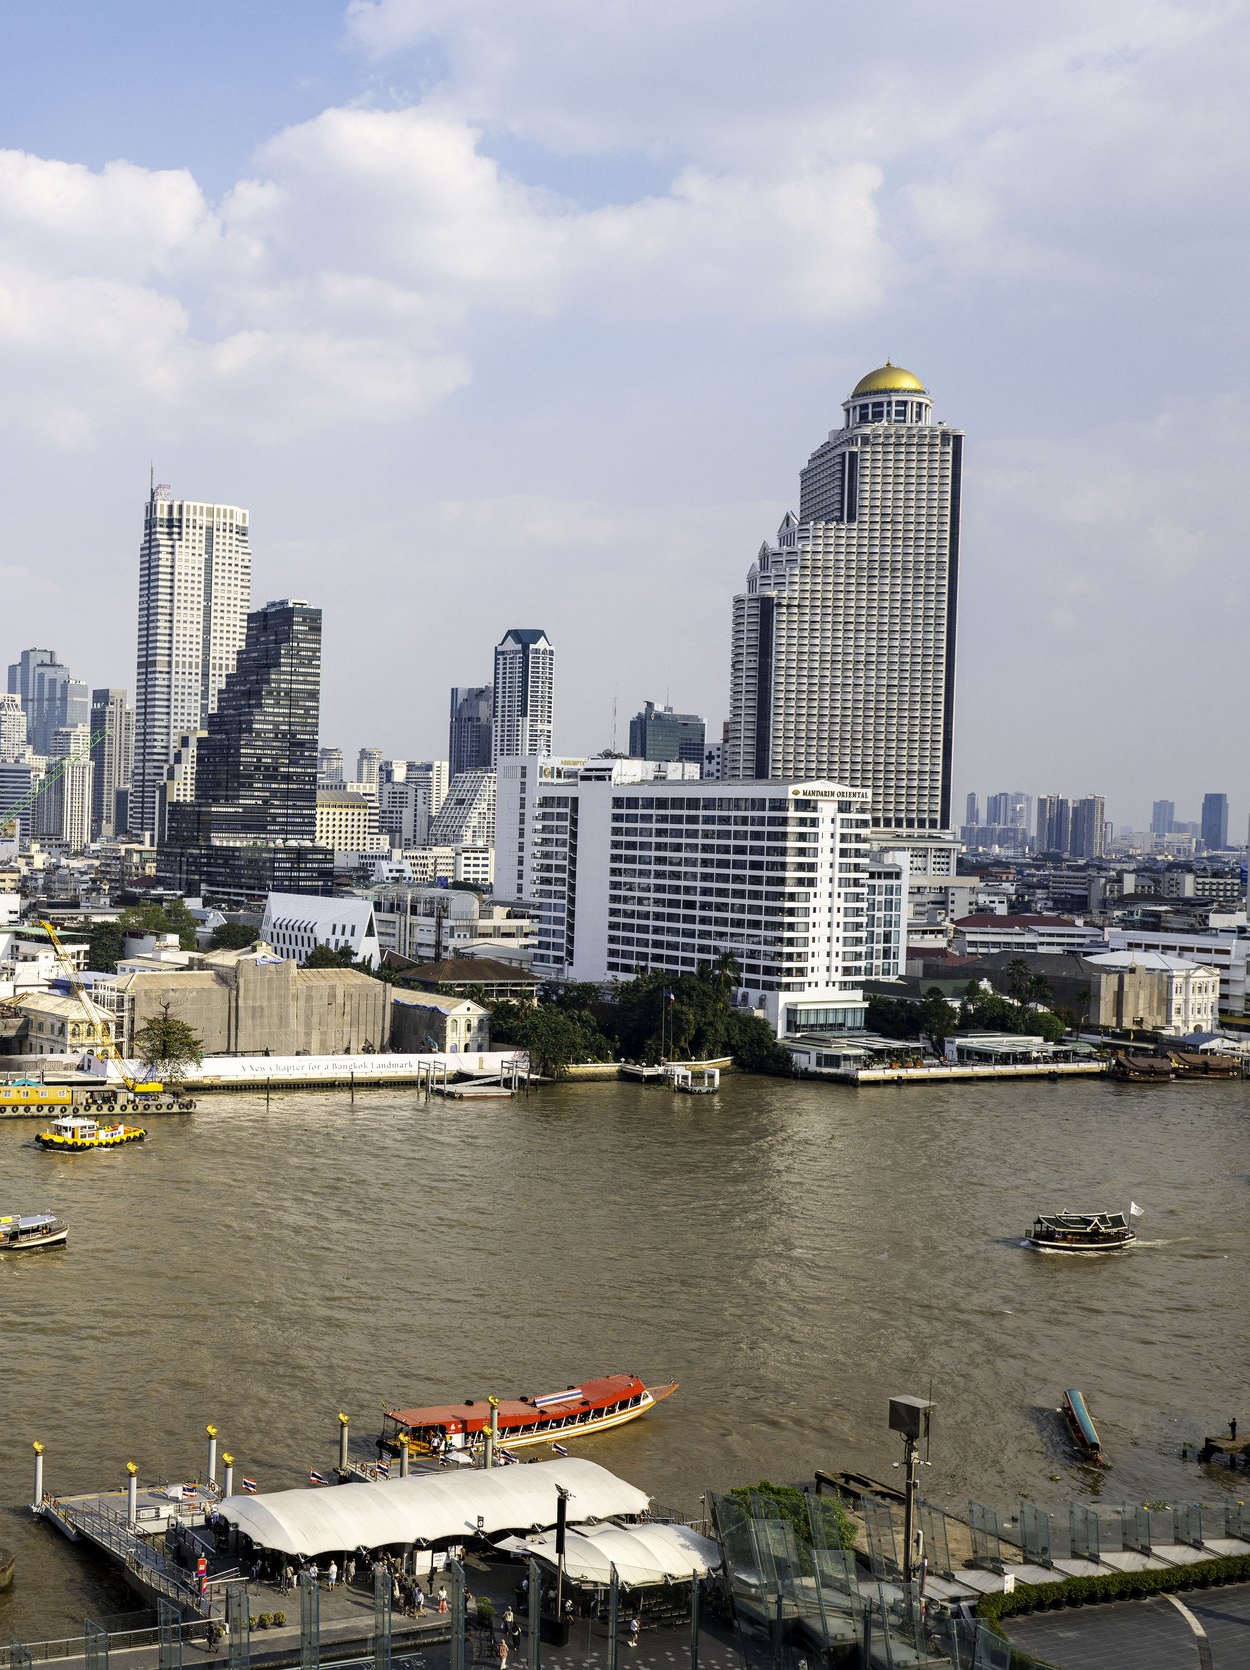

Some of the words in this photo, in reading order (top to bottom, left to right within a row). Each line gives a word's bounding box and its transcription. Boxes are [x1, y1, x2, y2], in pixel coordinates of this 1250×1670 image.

[802, 789, 835, 797] MANDARIN
[836, 790, 869, 799] ORIENTAL
[269, 1063, 305, 1073] Chapter
[308, 1062, 321, 1071] for
[332, 1061, 368, 1072] Bangkok
[370, 1060, 413, 1070] Landmark
